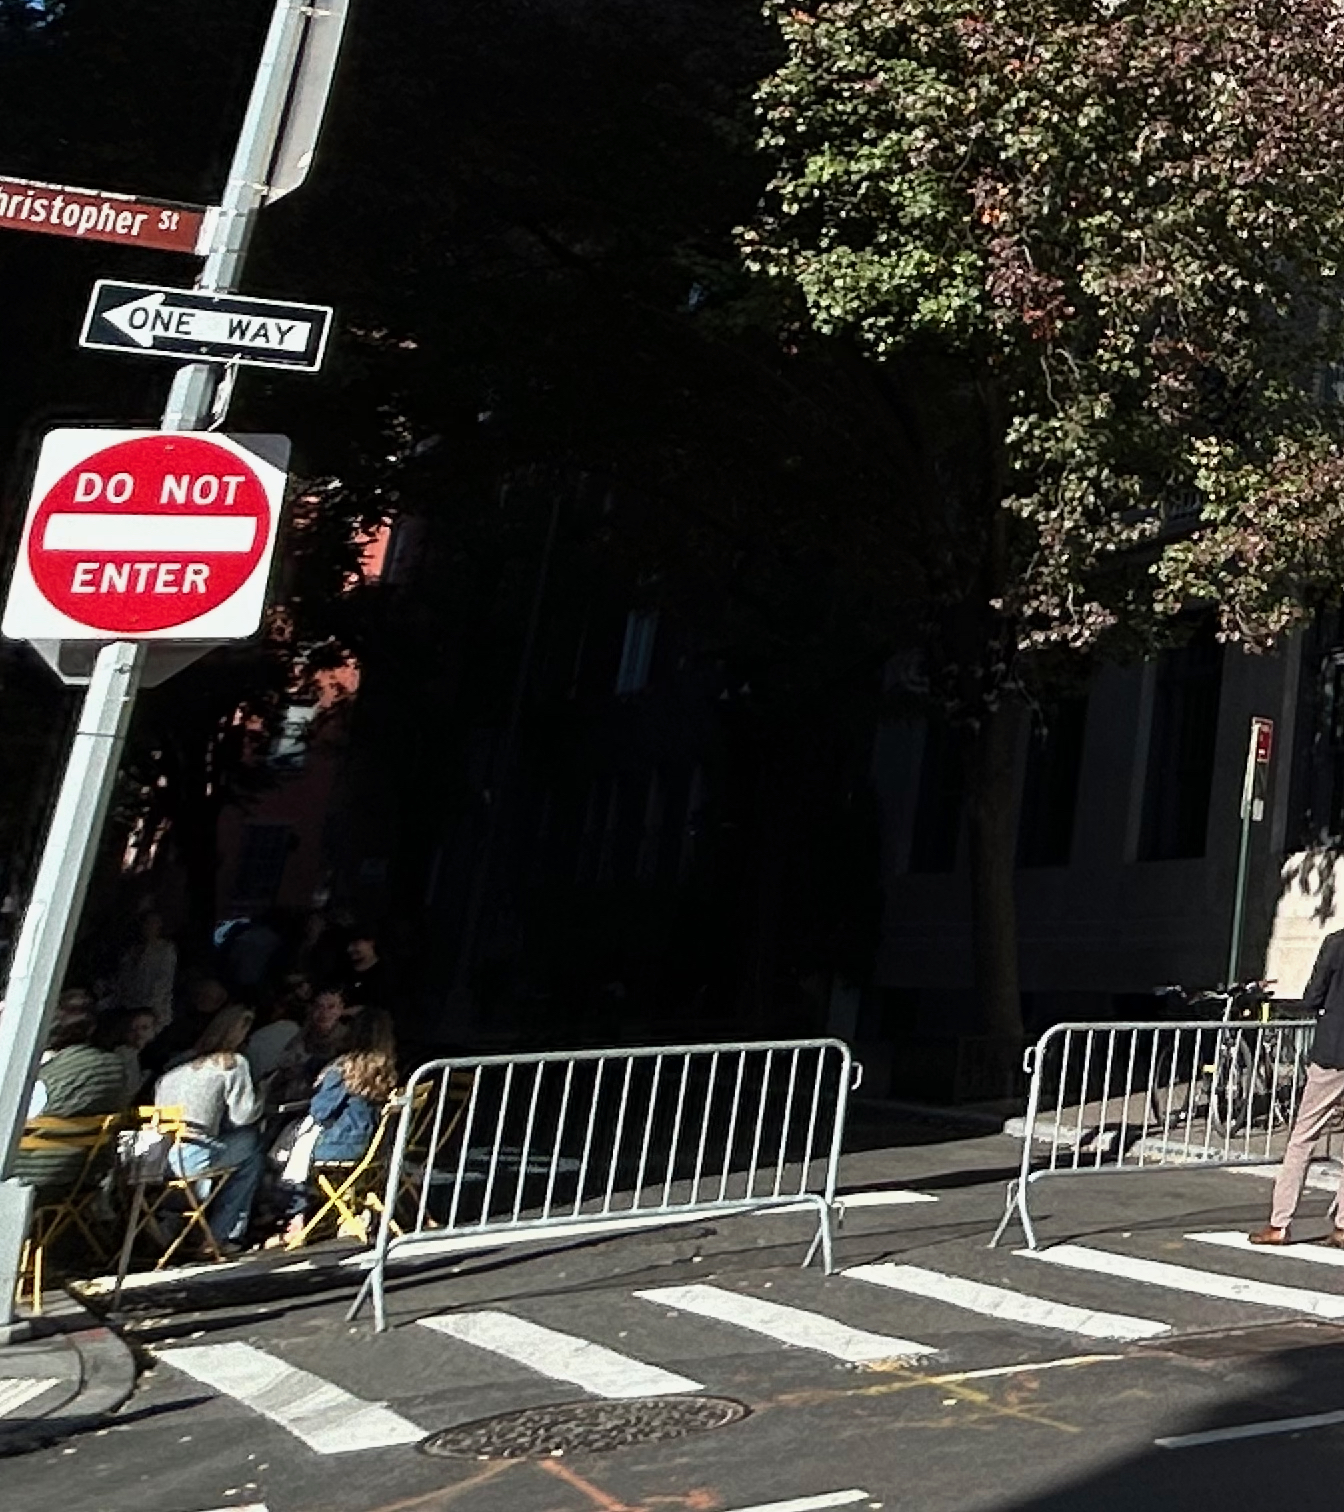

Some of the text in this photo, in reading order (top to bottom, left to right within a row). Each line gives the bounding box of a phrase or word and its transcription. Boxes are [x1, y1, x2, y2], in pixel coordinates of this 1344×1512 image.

[158, 210, 180, 232] St
[128, 306, 297, 347] ONE WAY
[74, 472, 246, 506] DO NOT
[71, 561, 210, 595] ENTER
